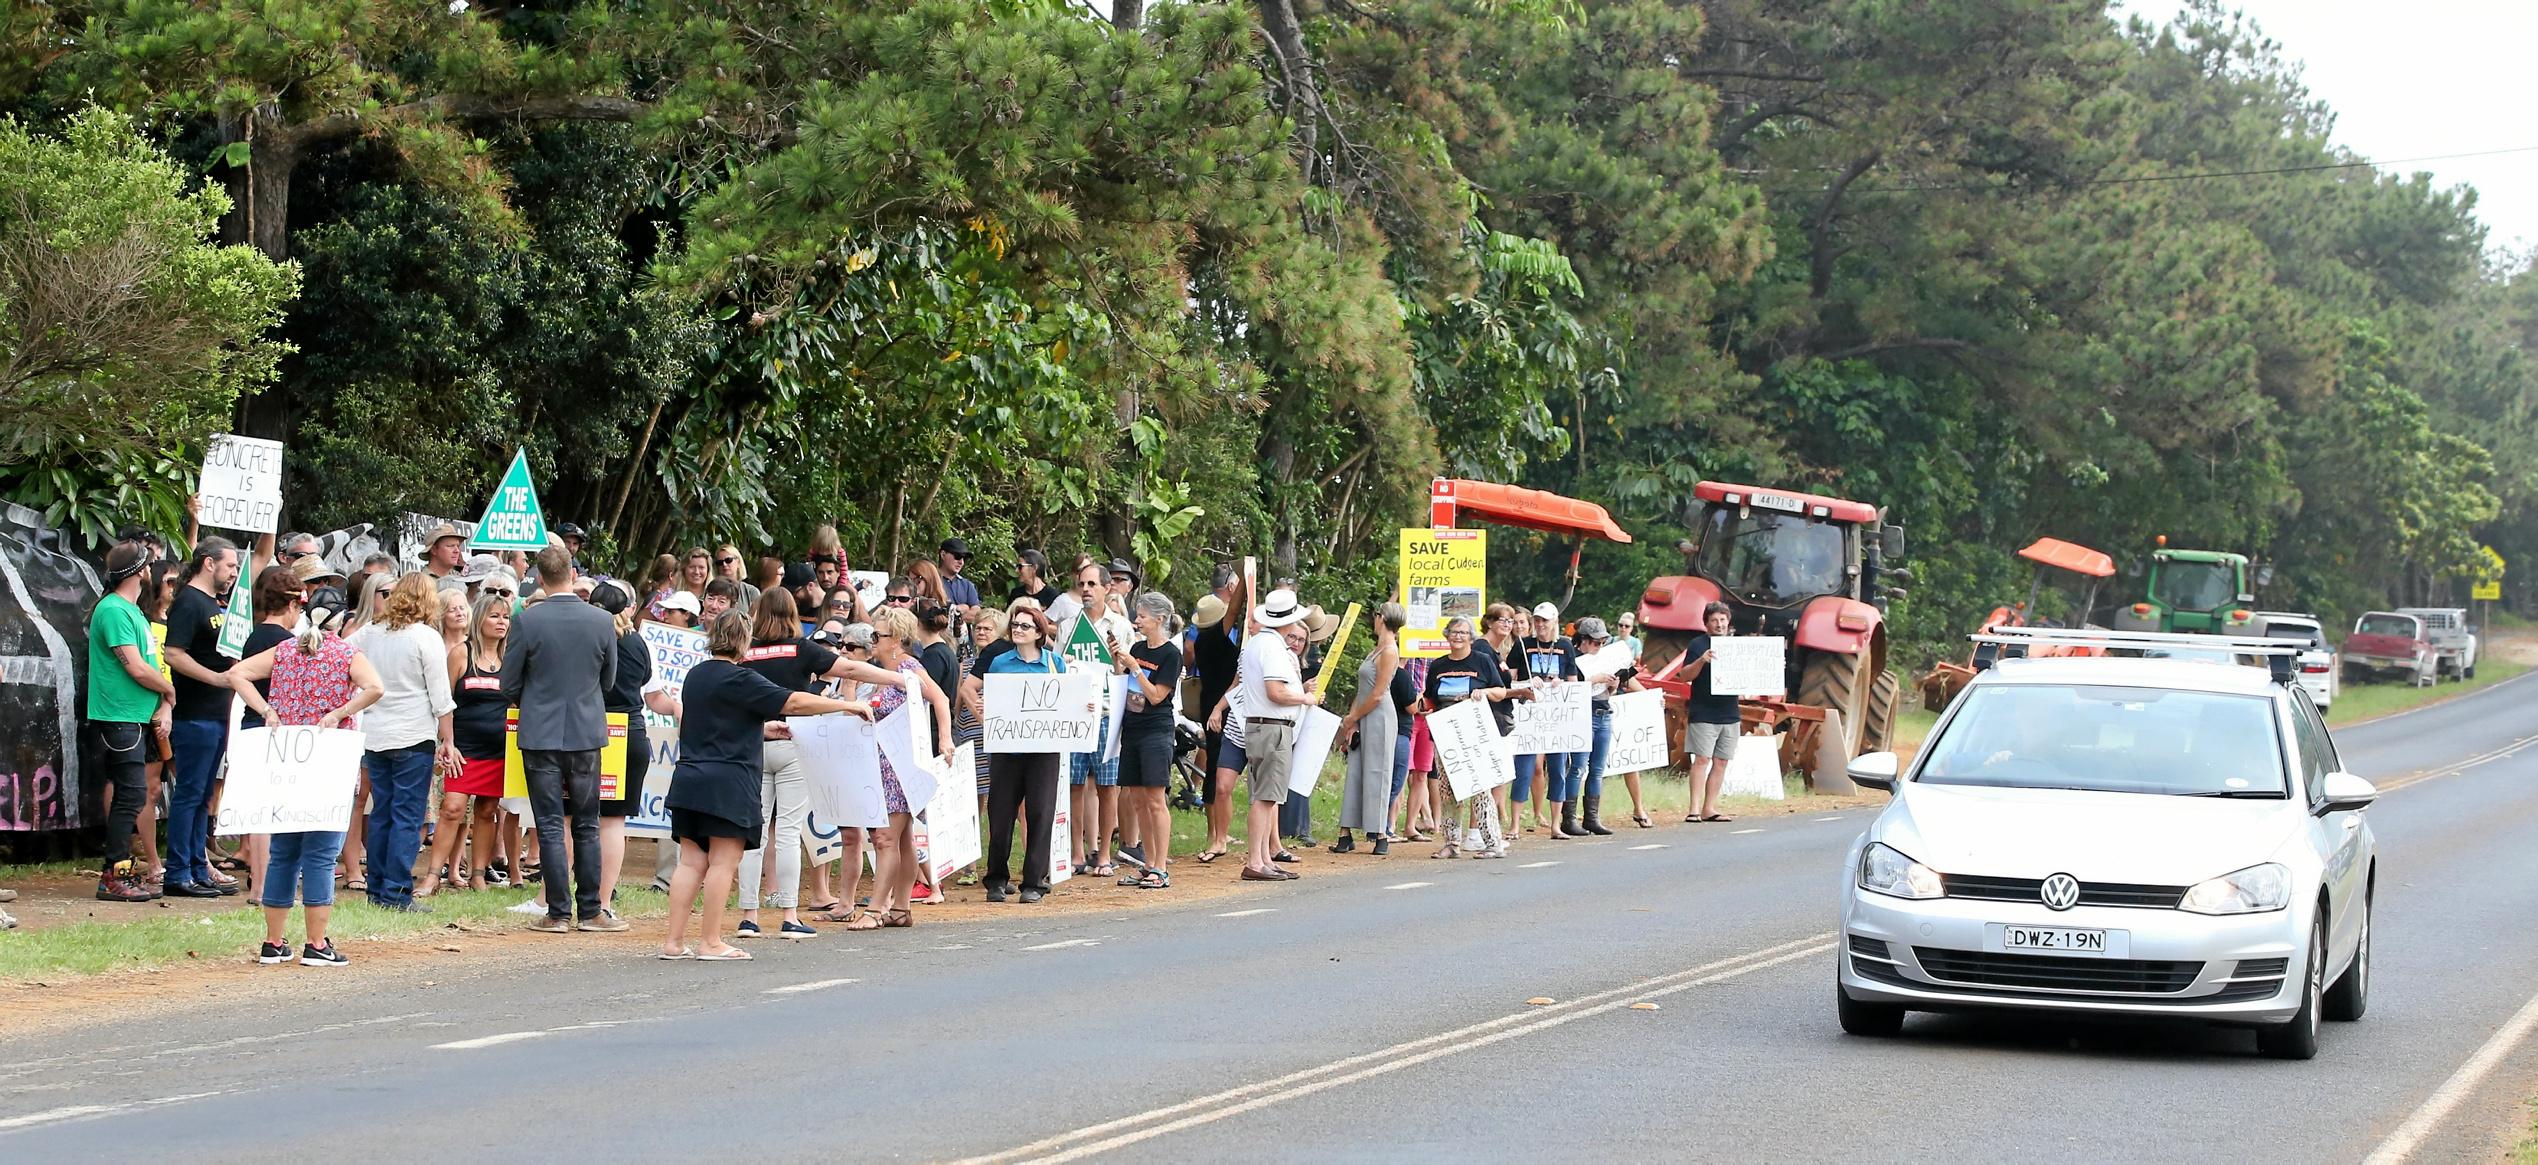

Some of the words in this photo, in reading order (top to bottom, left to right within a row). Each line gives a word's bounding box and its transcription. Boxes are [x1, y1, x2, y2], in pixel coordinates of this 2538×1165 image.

[239, 474, 253, 492] IS
[504, 486, 529, 512] THE
[1760, 494, 1785, 507] 44171
[204, 494, 274, 530] FOREVER
[487, 511, 538, 542] GREENS
[1409, 542, 1449, 555] SAVE
[1409, 557, 1445, 570] local
[1447, 556, 1485, 570] Cudgen
[1409, 573, 1450, 586] farms
[236, 587, 250, 616] THE
[645, 626, 683, 649] SAVE
[1072, 642, 1100, 662] THE
[1021, 679, 1060, 709] NO
[1472, 706, 1490, 744] Plateau
[1518, 705, 1580, 722] DROUGHT
[985, 716, 1092, 740] TRANSPARENCY
[1535, 721, 1558, 733] FREE
[1633, 725, 1655, 744] OF
[266, 728, 314, 763] NO
[1447, 717, 1483, 794] Development
[1605, 743, 1666, 769] NGSCLIFF
[1443, 748, 1462, 775] NO
[218, 808, 246, 828] City
